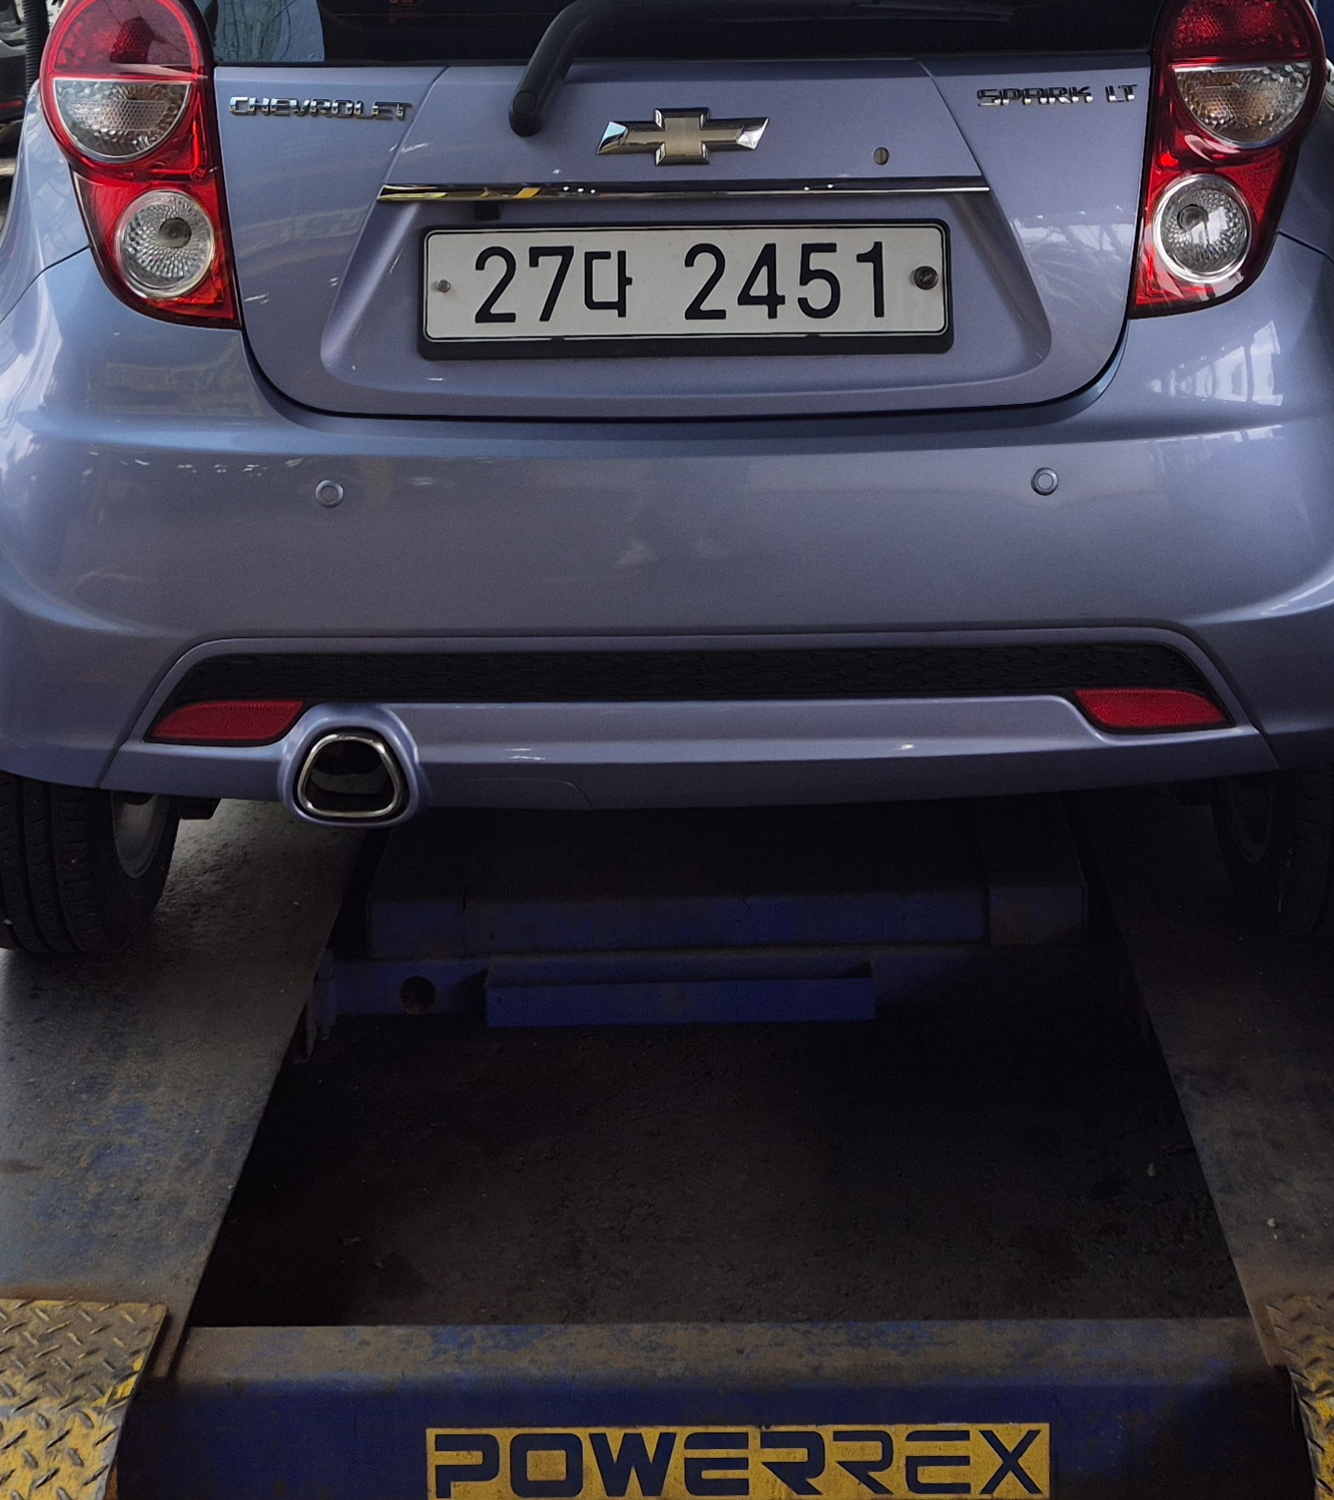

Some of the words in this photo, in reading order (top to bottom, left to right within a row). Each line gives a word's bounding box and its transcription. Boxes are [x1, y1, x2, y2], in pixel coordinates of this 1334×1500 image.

[229, 96, 413, 121] CHEVROLET
[977, 86, 1094, 107] SPARK
[1105, 84, 1138, 103] LT
[474, 245, 633, 324] 27다
[684, 241, 885, 321] 2451
[434, 1429, 1043, 1498] POWERREX
